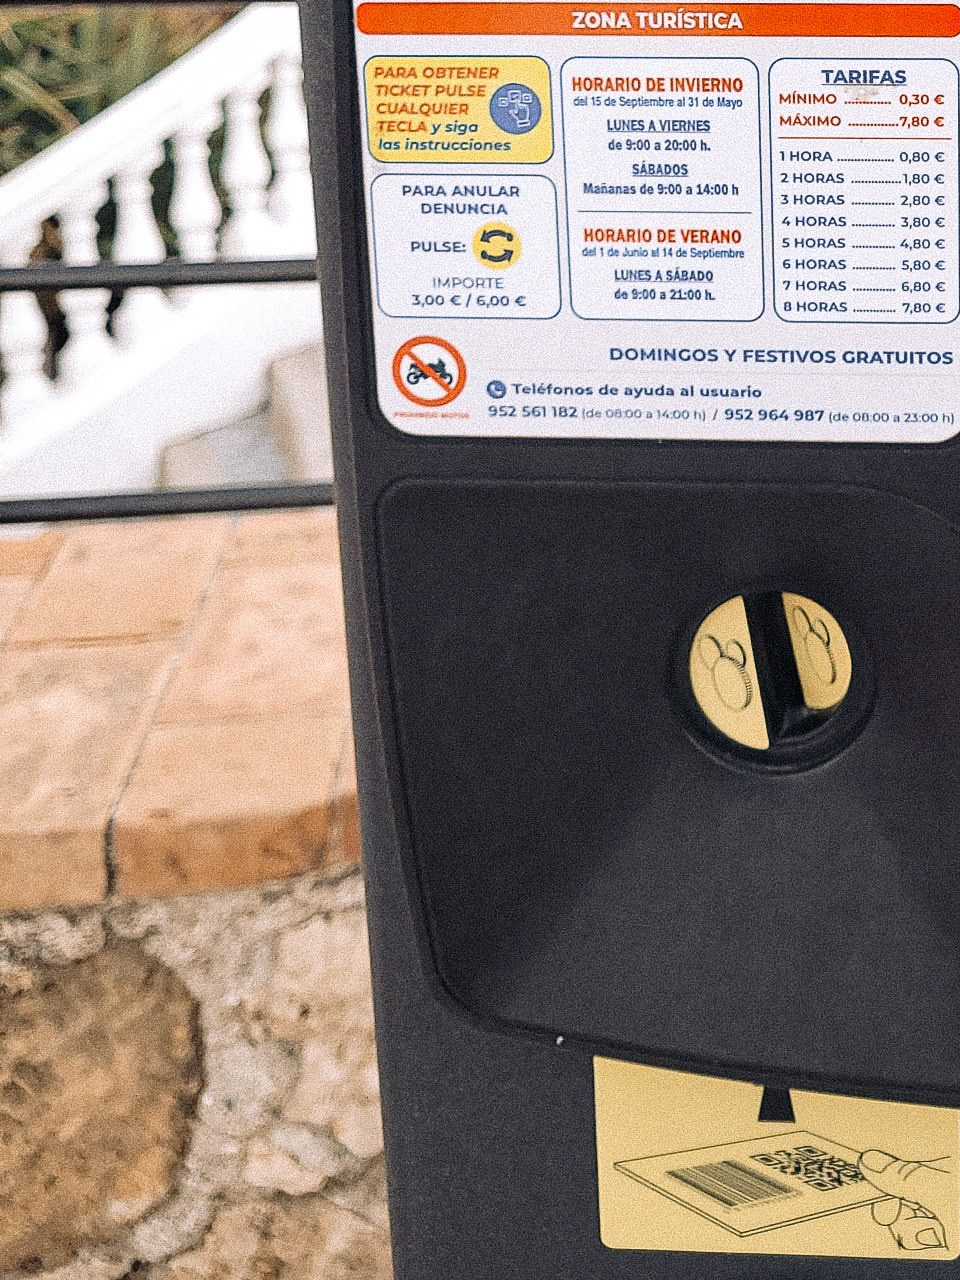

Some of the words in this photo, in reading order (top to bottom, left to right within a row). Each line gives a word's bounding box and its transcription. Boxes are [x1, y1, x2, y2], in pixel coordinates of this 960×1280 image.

[572, 12, 631, 28] ZONA
[636, 8, 742, 28] TURÍSTICA
[374, 67, 417, 78] PARA
[423, 67, 499, 79] OBTENER
[822, 70, 906, 86] TARIFAS
[572, 77, 641, 91] HORARIO
[646, 78, 665, 92] DE
[670, 78, 743, 92] INVIERNO
[376, 85, 431, 96] TICKET
[435, 85, 486, 97] PULSE
[779, 91, 837, 104] MÍNIMO
[899, 94, 929, 106] 0,30
[934, 95, 944, 105] €
[376, 103, 469, 117] CUALQUIER
[378, 121, 427, 132] TECLA
[431, 124, 441, 135] y
[445, 120, 478, 135] siga
[607, 120, 644, 131] LUNES
[650, 121, 656, 131] A
[660, 120, 710, 132] VIERNES
[379, 139, 400, 150] las
[405, 138, 510, 150] instrucciones
[608, 140, 622, 150] de
[626, 139, 650, 150] 9:00
[654, 142, 661, 150] a
[665, 139, 697, 151] 20:00
[701, 140, 710, 151] h.
[780, 151, 784, 161] 1
[790, 151, 832, 161] HORA
[900, 152, 930, 163] 0,80
[935, 152, 944, 162] €
[632, 161, 688, 175] SÁBADOS
[781, 173, 788, 183] 2
[793, 173, 844, 183] HORAS
[904, 174, 930, 185] 1,80
[934, 174, 944, 184] €
[402, 185, 446, 196] PARA
[452, 186, 519, 197] ANULAR
[584, 183, 636, 194] Mañanas
[640, 184, 654, 194] de
[658, 184, 682, 194] 9:00
[686, 186, 692, 195] a
[697, 184, 728, 195] 14:00
[421, 203, 507, 214] DENUNCIA
[782, 217, 790, 226] 4
[796, 217, 846, 227] HORAS
[901, 217, 930, 228] 3,80
[935, 217, 945, 227] €
[584, 229, 652, 242] HORARIO
[657, 229, 675, 243] DE
[681, 230, 741, 243] VERANO
[411, 241, 466, 252] PULSE:
[615, 270, 651, 280] LUNES
[655, 270, 662, 280] A
[666, 268, 713, 282] SÁBADO
[433, 277, 503, 289] IMPORTE
[784, 302, 791, 311] 8
[797, 302, 847, 312] HORAS
[902, 303, 931, 313] 7,80
[936, 303, 945, 313] €
[610, 348, 718, 362] DOMINGOS
[725, 350, 736, 361] Y
[743, 350, 836, 363] FESTIVOS
[842, 351, 953, 364] GRATUITOS
[512, 383, 593, 395] Teléfonos
[599, 385, 618, 395] de
[624, 385, 674, 398] ayuda
[681, 386, 694, 396] al
[700, 386, 761, 397] usuario
[489, 406, 516, 417] 952
[522, 406, 546, 417] 561
[553, 407, 577, 417] 182
[725, 409, 753, 420] 952
[758, 410, 788, 420] 964
[794, 410, 824, 421] 987
